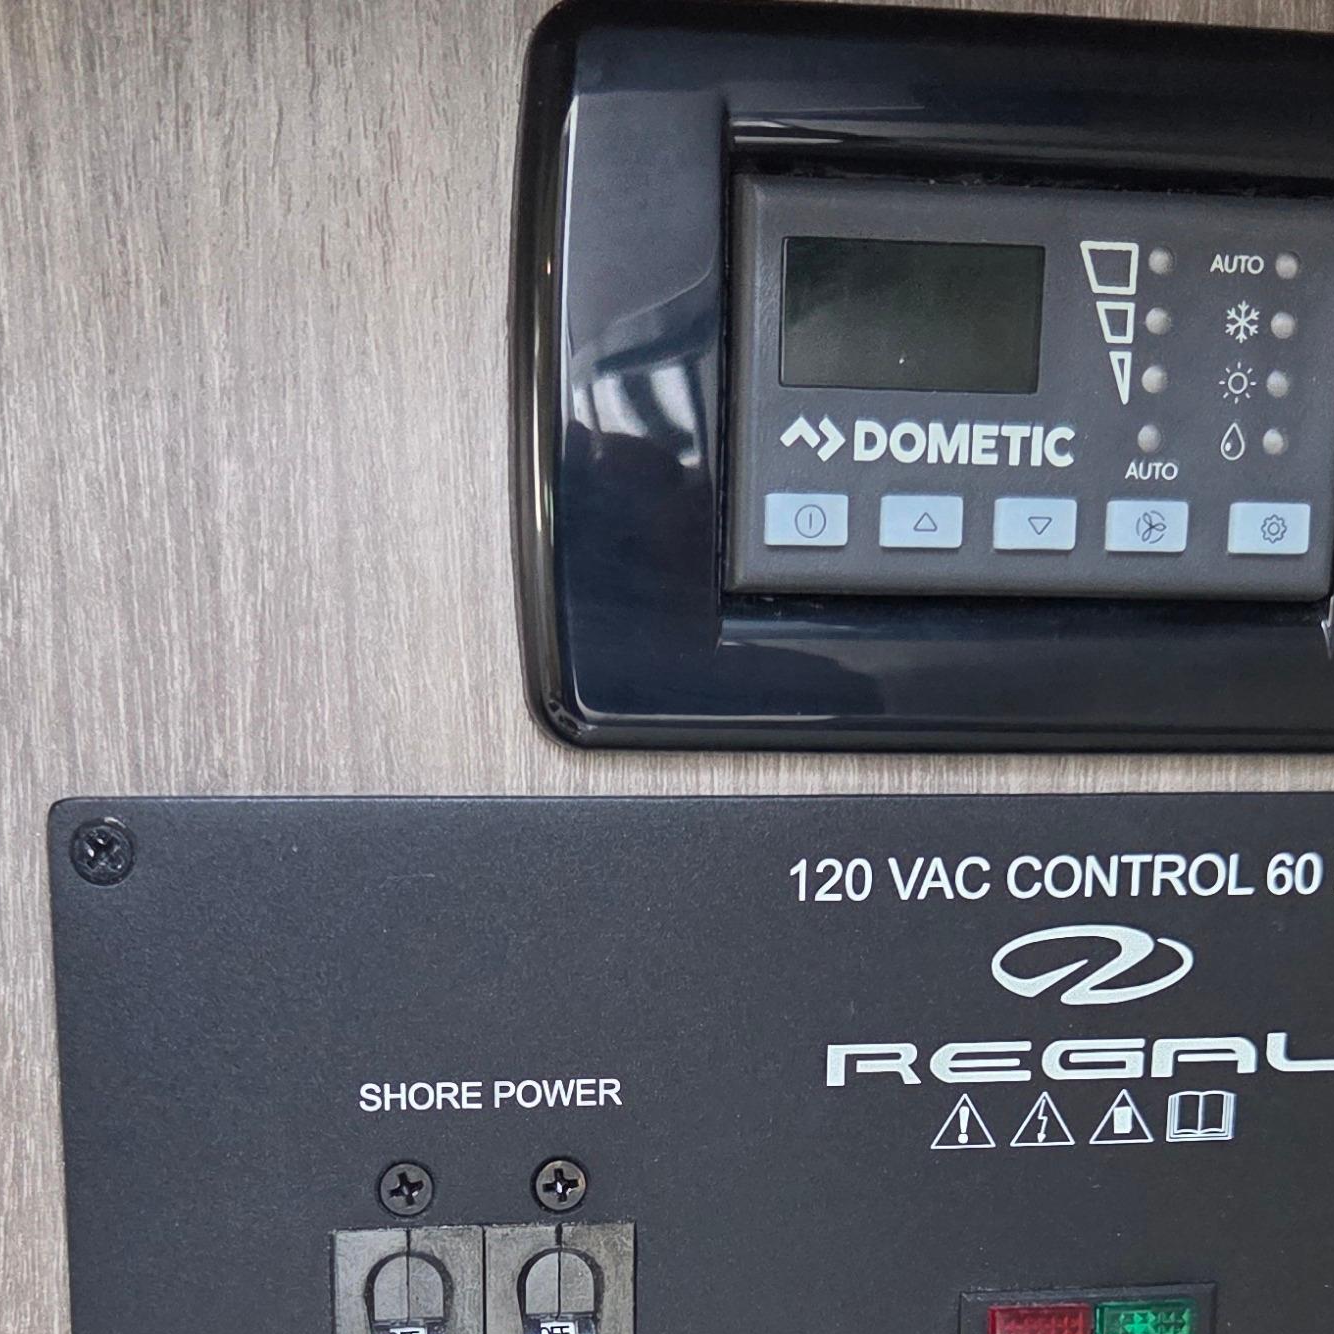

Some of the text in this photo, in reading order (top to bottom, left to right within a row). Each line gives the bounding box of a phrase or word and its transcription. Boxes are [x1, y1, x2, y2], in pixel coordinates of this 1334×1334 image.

[1210, 253, 1264, 276] AUTO
[854, 420, 1075, 468] DOMETIC
[1125, 460, 1178, 481] AUTO
[790, 858, 872, 901] 120
[888, 856, 990, 900] VAC
[1007, 853, 1254, 898] CONTROL
[1267, 853, 1322, 896] 60
[359, 1078, 622, 1111] SHORE POWER
